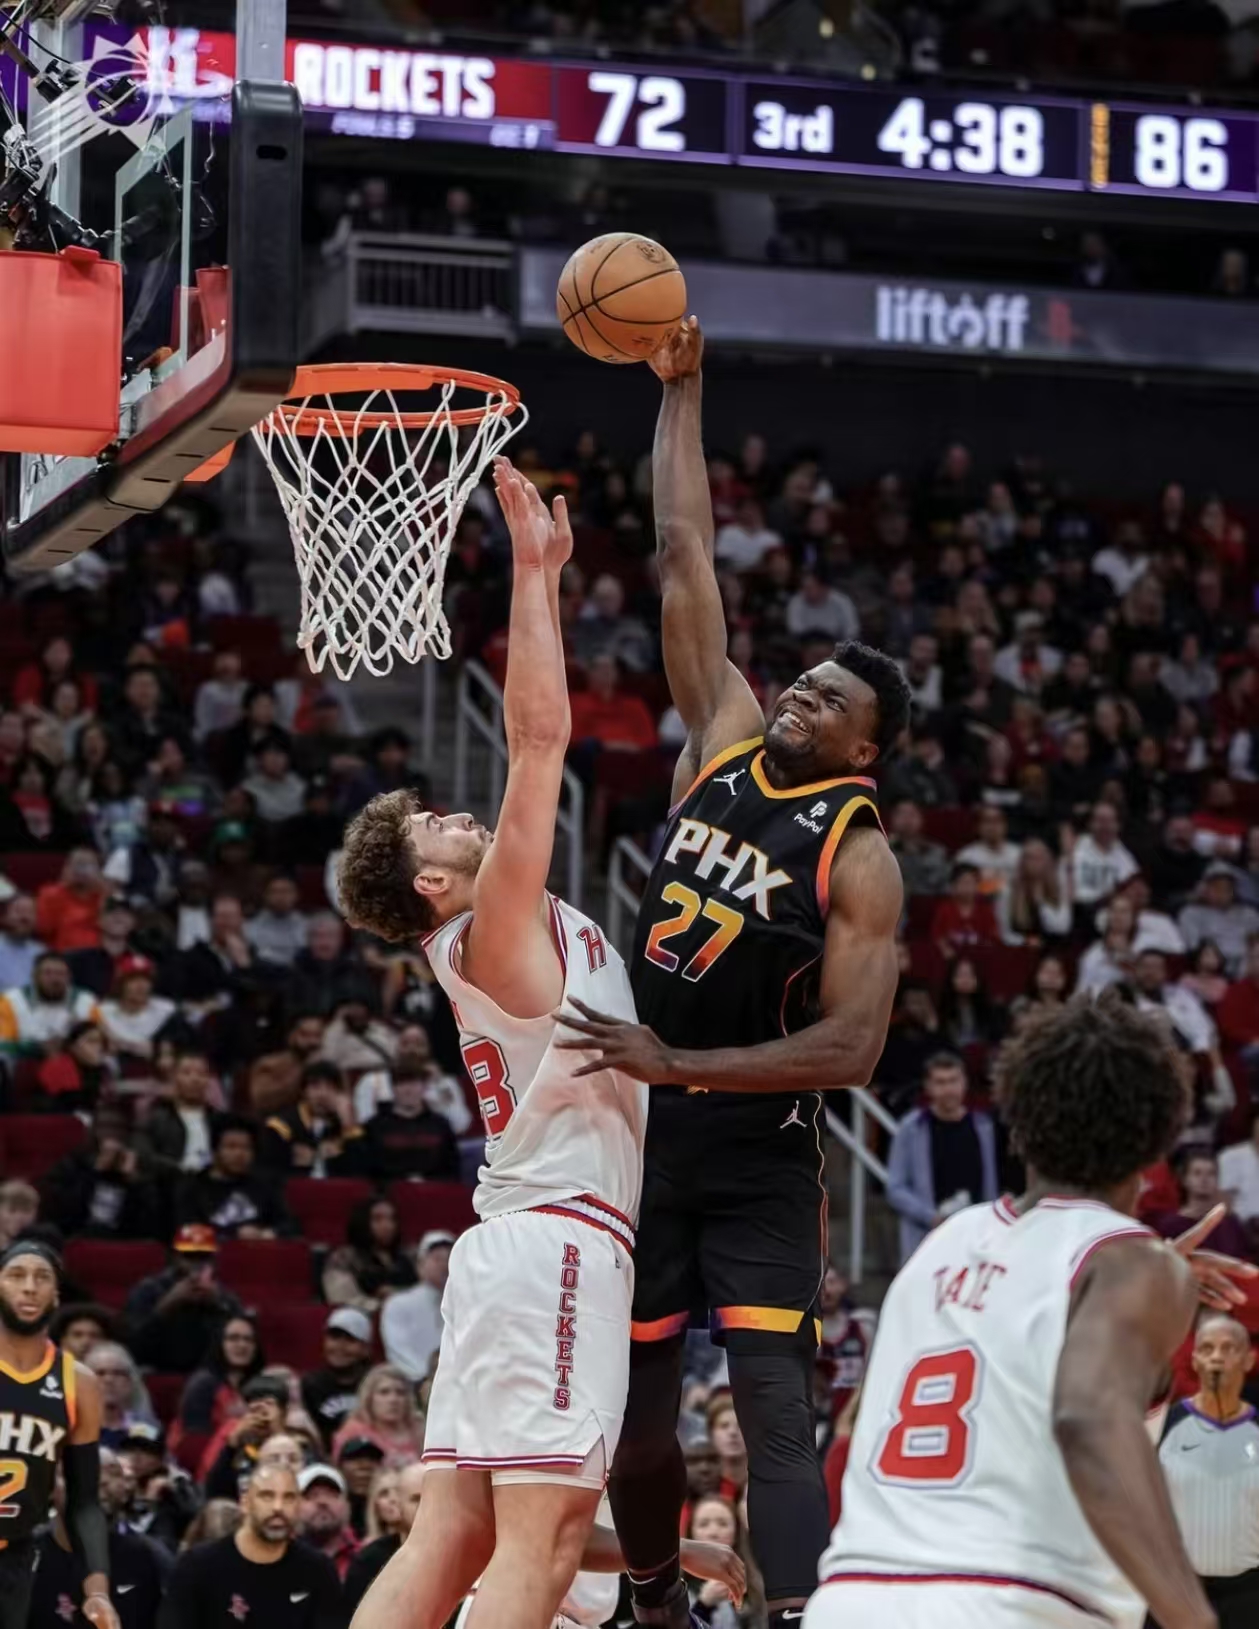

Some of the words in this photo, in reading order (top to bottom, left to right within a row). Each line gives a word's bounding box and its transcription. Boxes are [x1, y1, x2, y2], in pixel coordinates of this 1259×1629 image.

[293, 43, 496, 120] ROCKETS
[588, 71, 687, 153] 72
[753, 101, 834, 154] 3rd
[877, 97, 1044, 178] 4:38
[1134, 113, 1229, 192] 86
[876, 285, 1030, 351] liftoff
[793, 812, 824, 834] PayPal
[663, 817, 794, 922] PHX
[644, 880, 745, 983] 27
[553, 1241, 581, 1411] ROCKETS
[0, 1411, 66, 1462] HX
[867, 1337, 987, 1490] 8
